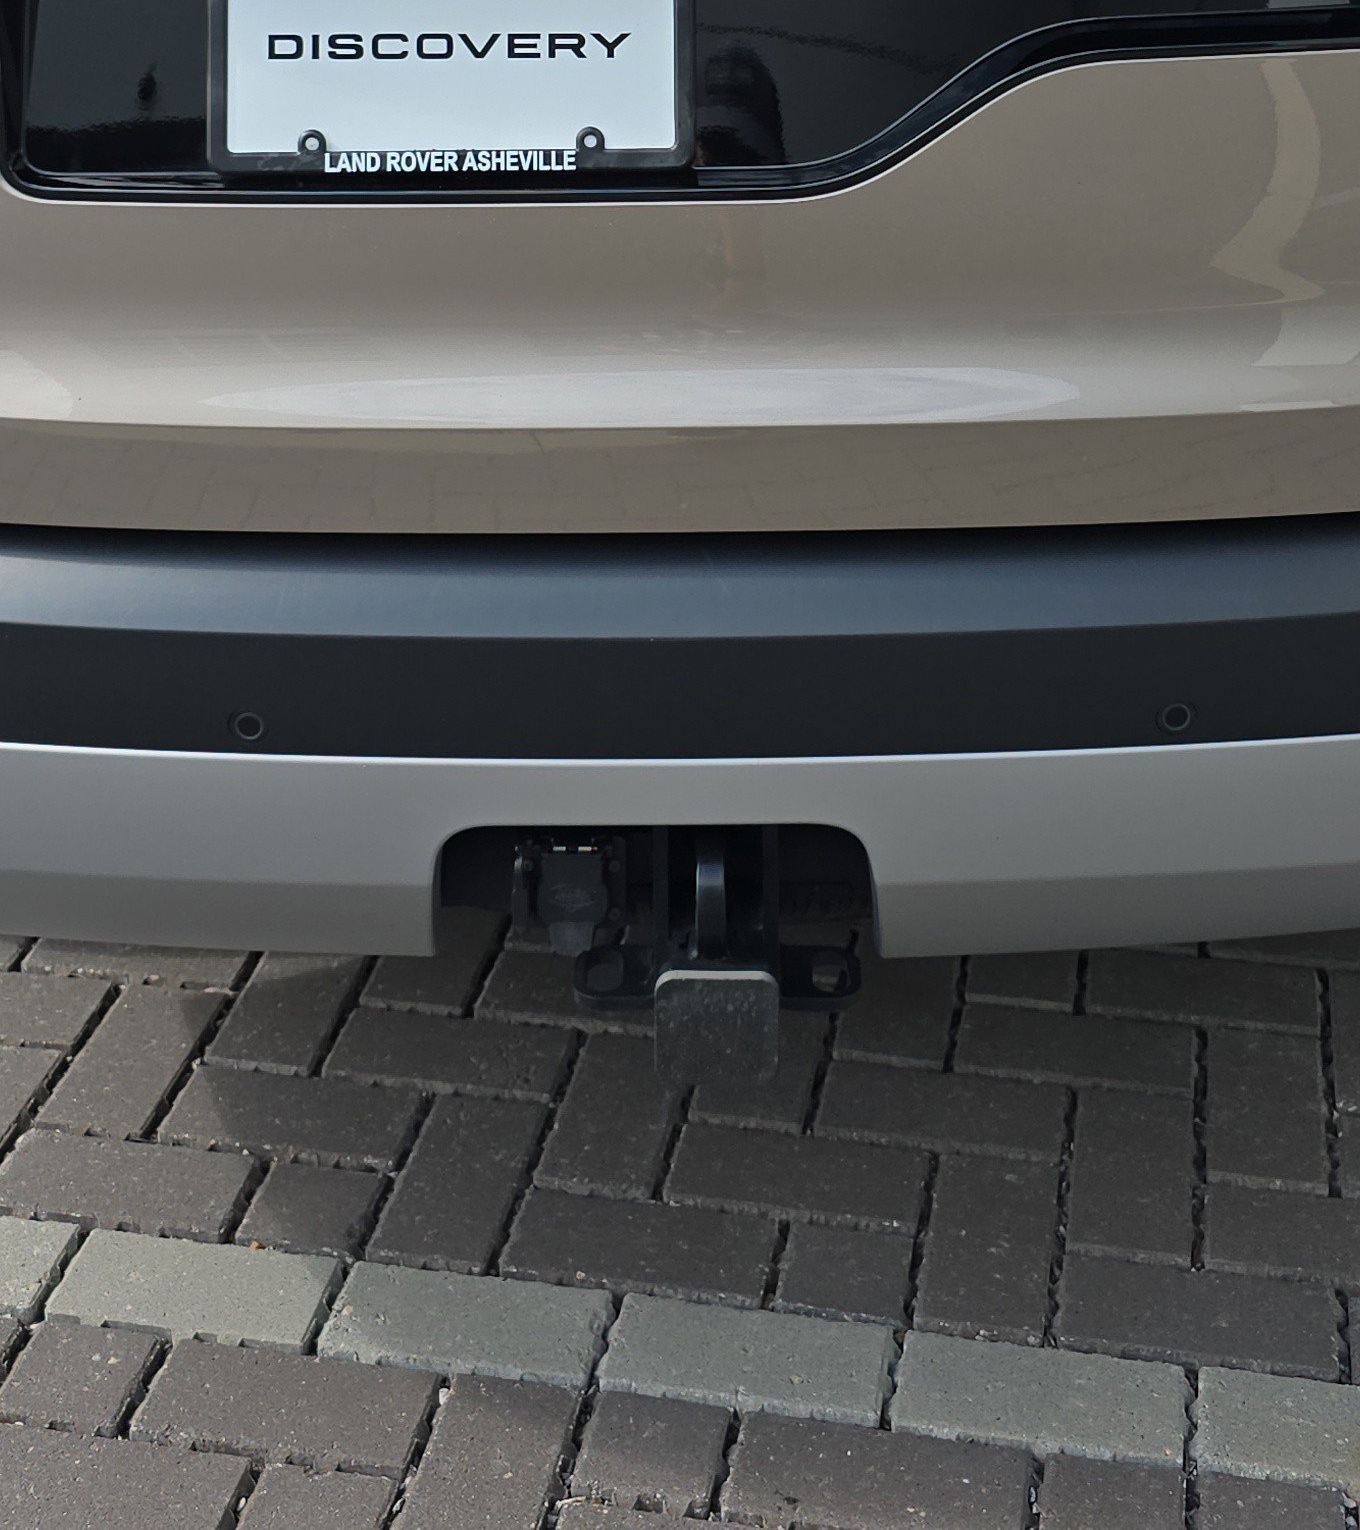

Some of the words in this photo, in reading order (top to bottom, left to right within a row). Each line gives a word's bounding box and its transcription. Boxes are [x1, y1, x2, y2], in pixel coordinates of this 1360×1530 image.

[267, 32, 632, 60] DISCOVERY
[324, 152, 381, 173] LAND
[386, 151, 458, 172] ROVER
[462, 150, 577, 171] ASHEVILLE
